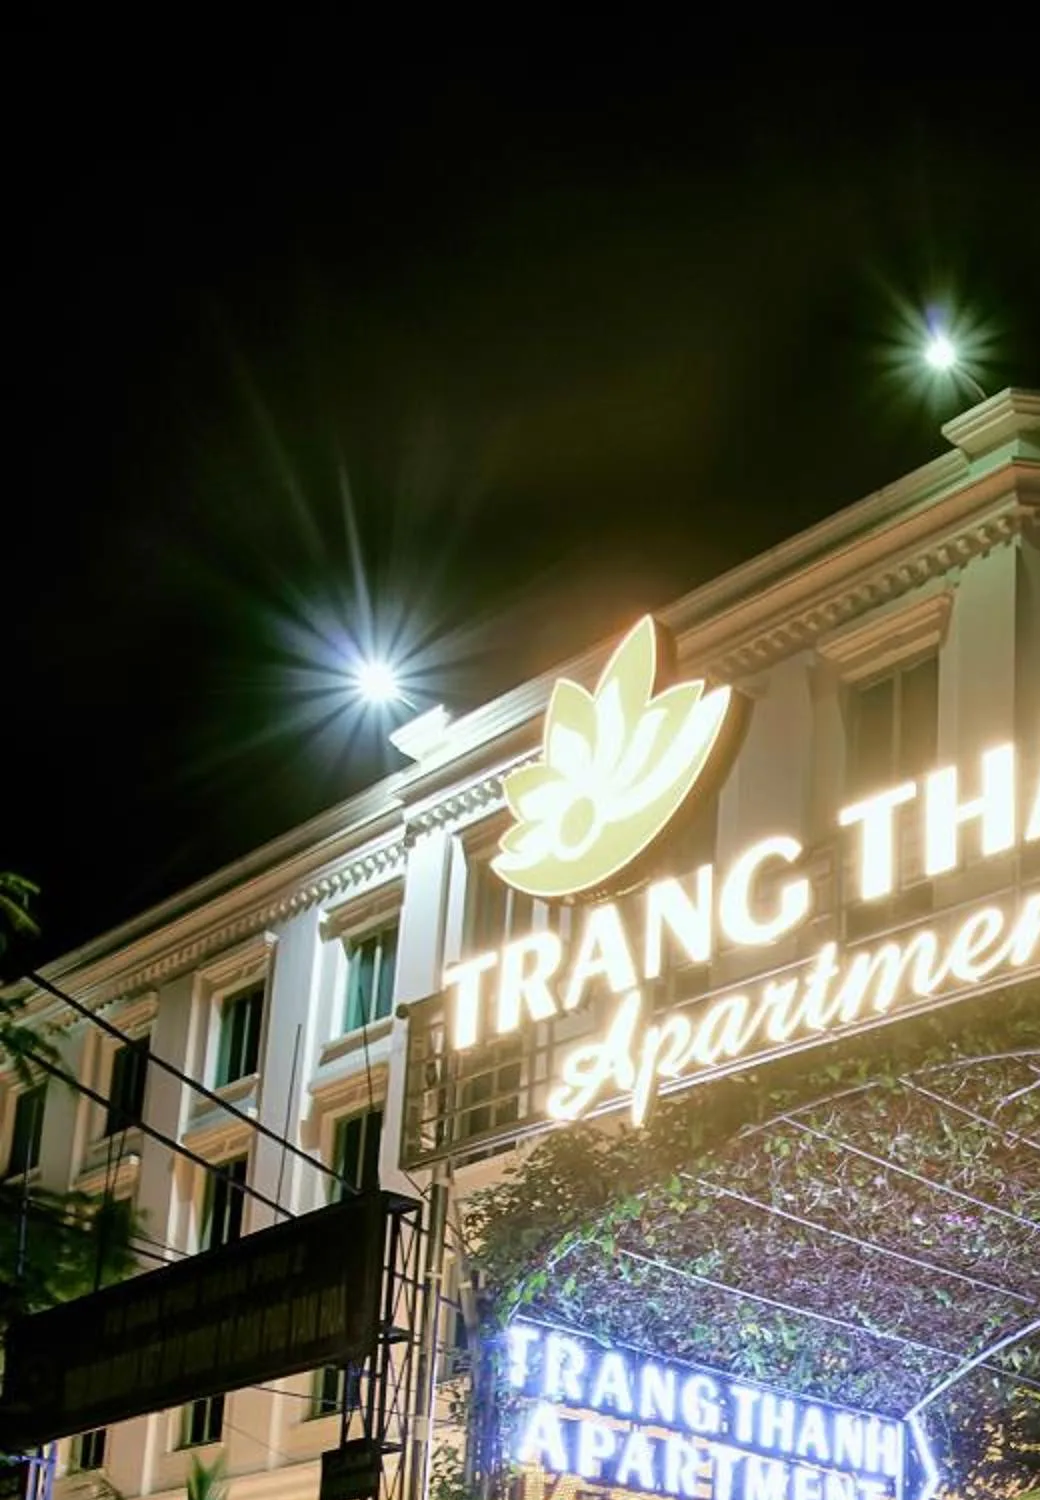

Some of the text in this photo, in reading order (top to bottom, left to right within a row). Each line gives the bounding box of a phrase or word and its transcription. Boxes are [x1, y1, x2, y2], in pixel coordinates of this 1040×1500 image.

[443, 836, 811, 1050] TRANG
[507, 1325, 897, 1476] TRANG THANH
